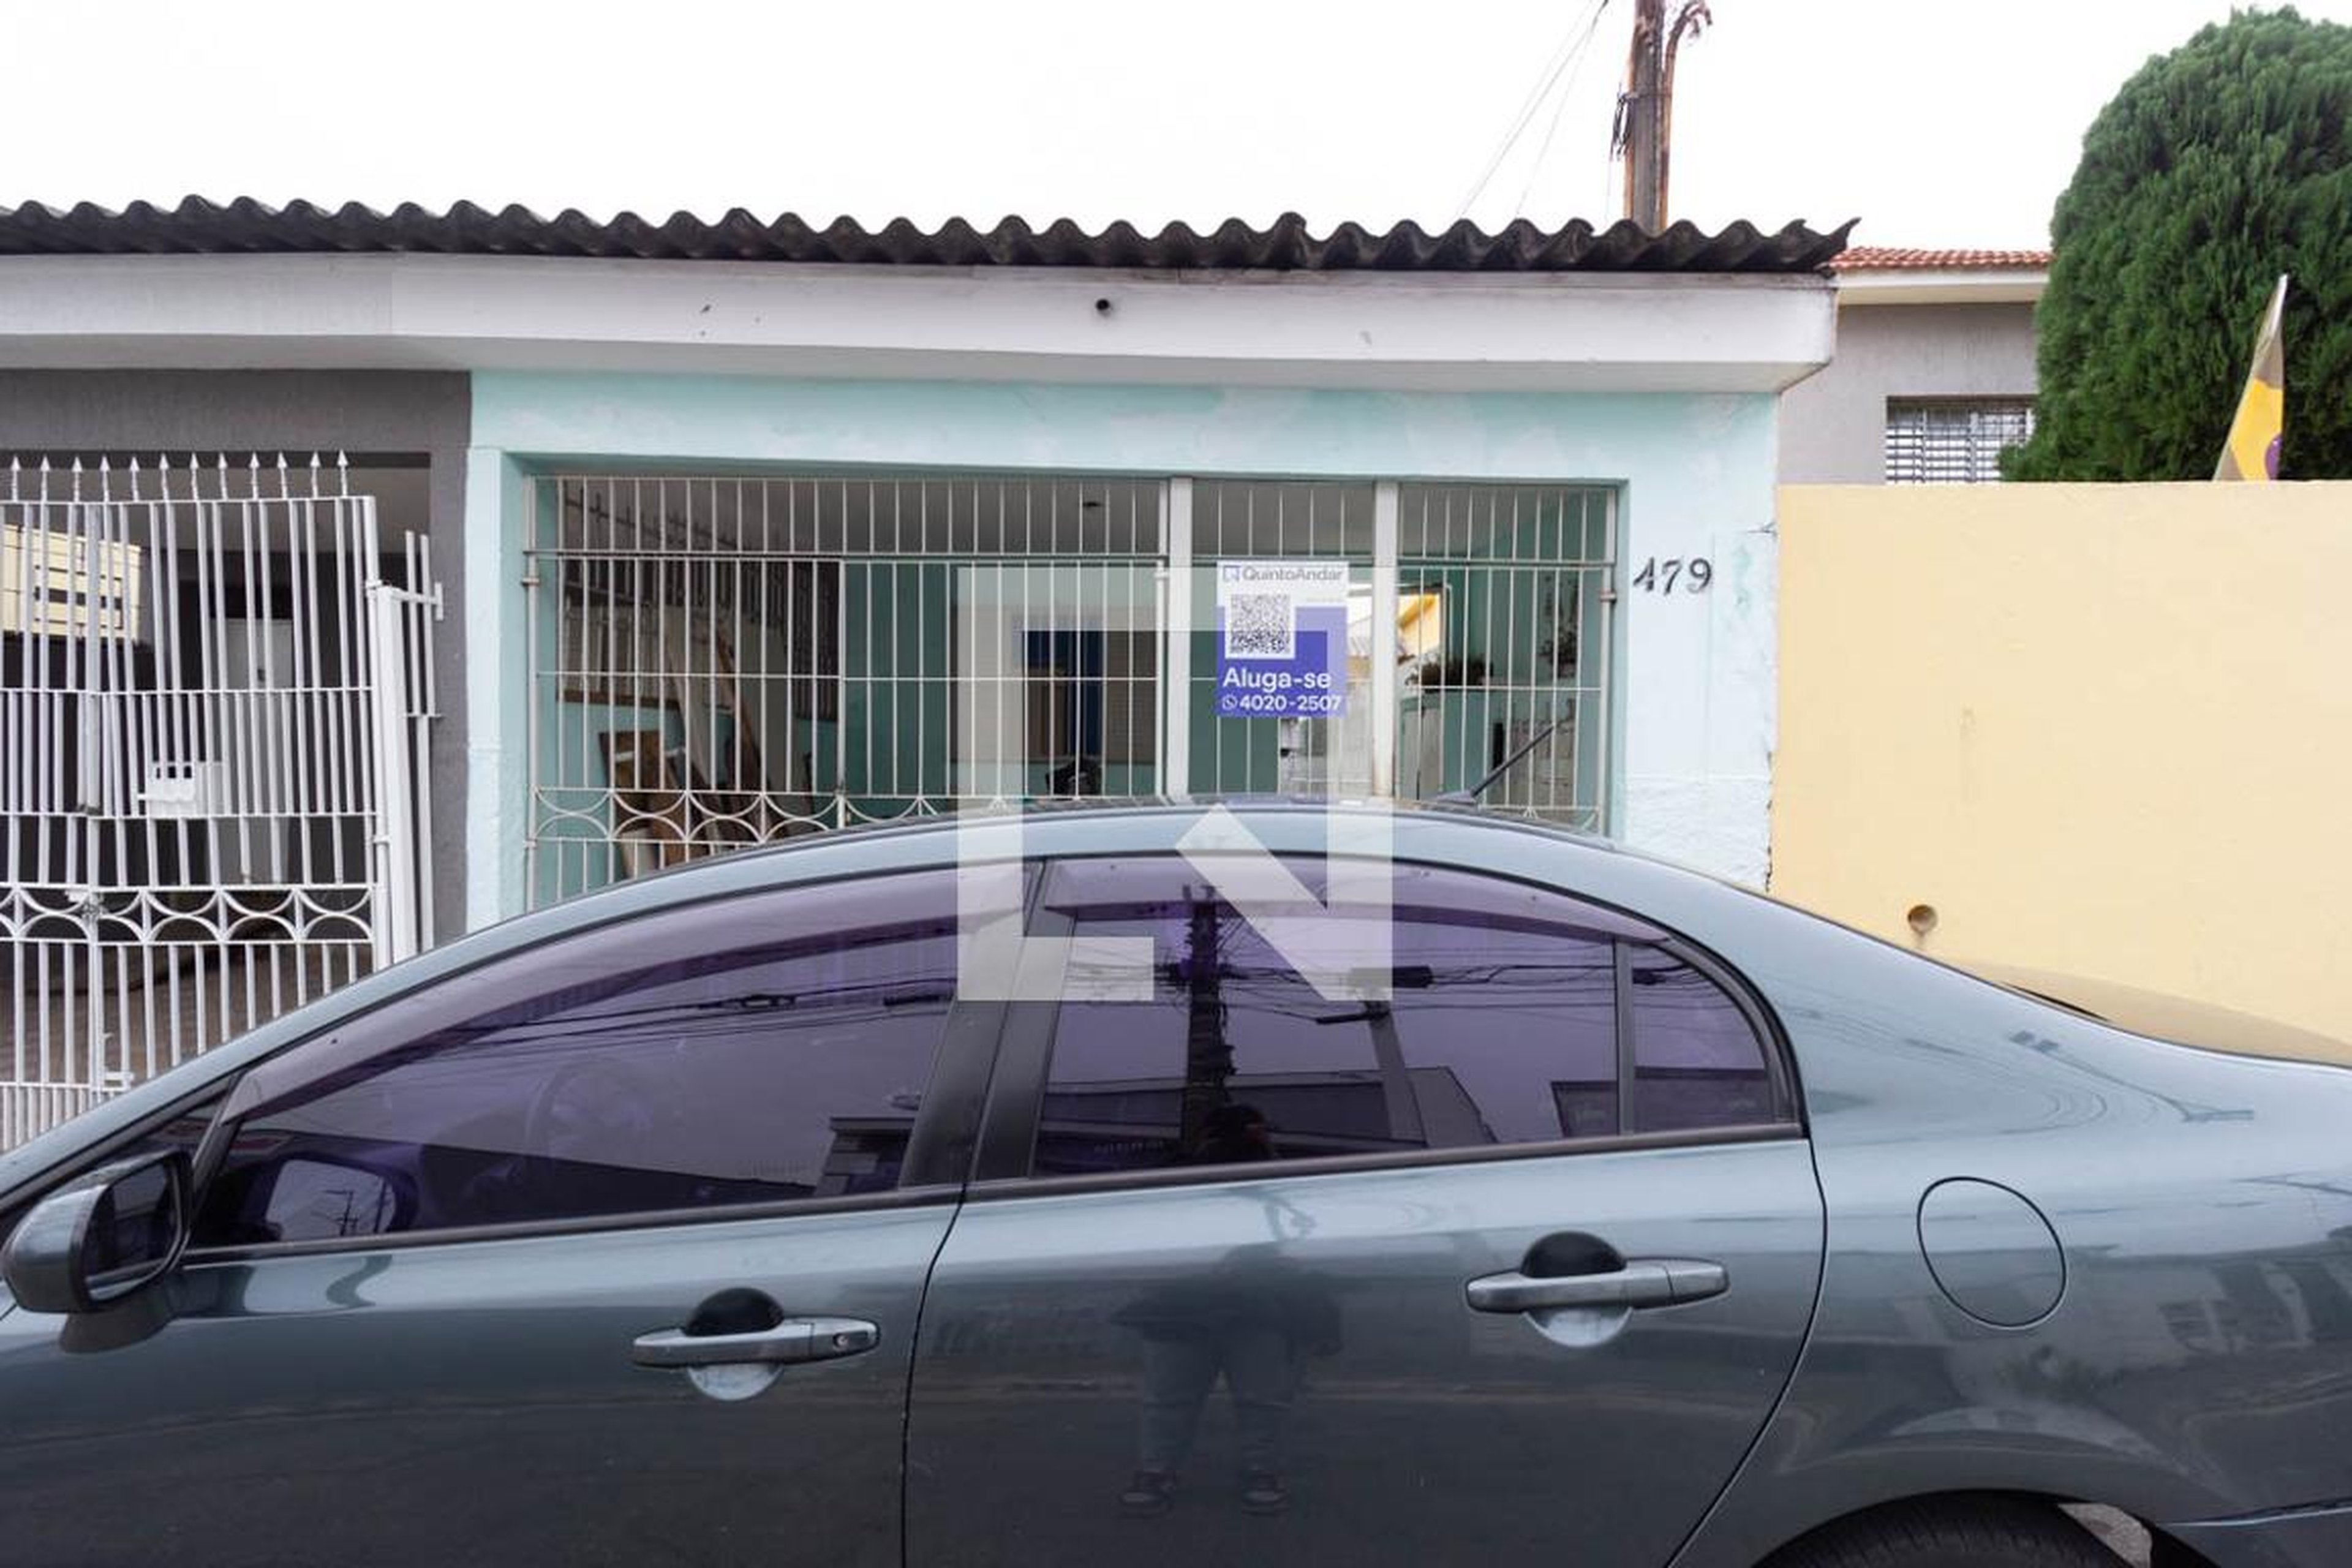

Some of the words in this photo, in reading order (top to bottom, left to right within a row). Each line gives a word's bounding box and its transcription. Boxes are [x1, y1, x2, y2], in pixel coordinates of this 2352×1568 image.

[1243, 567, 1343, 581] QuintoAndar
[1633, 557, 1712, 595] 479
[1223, 667, 1332, 693] Aluga-se
